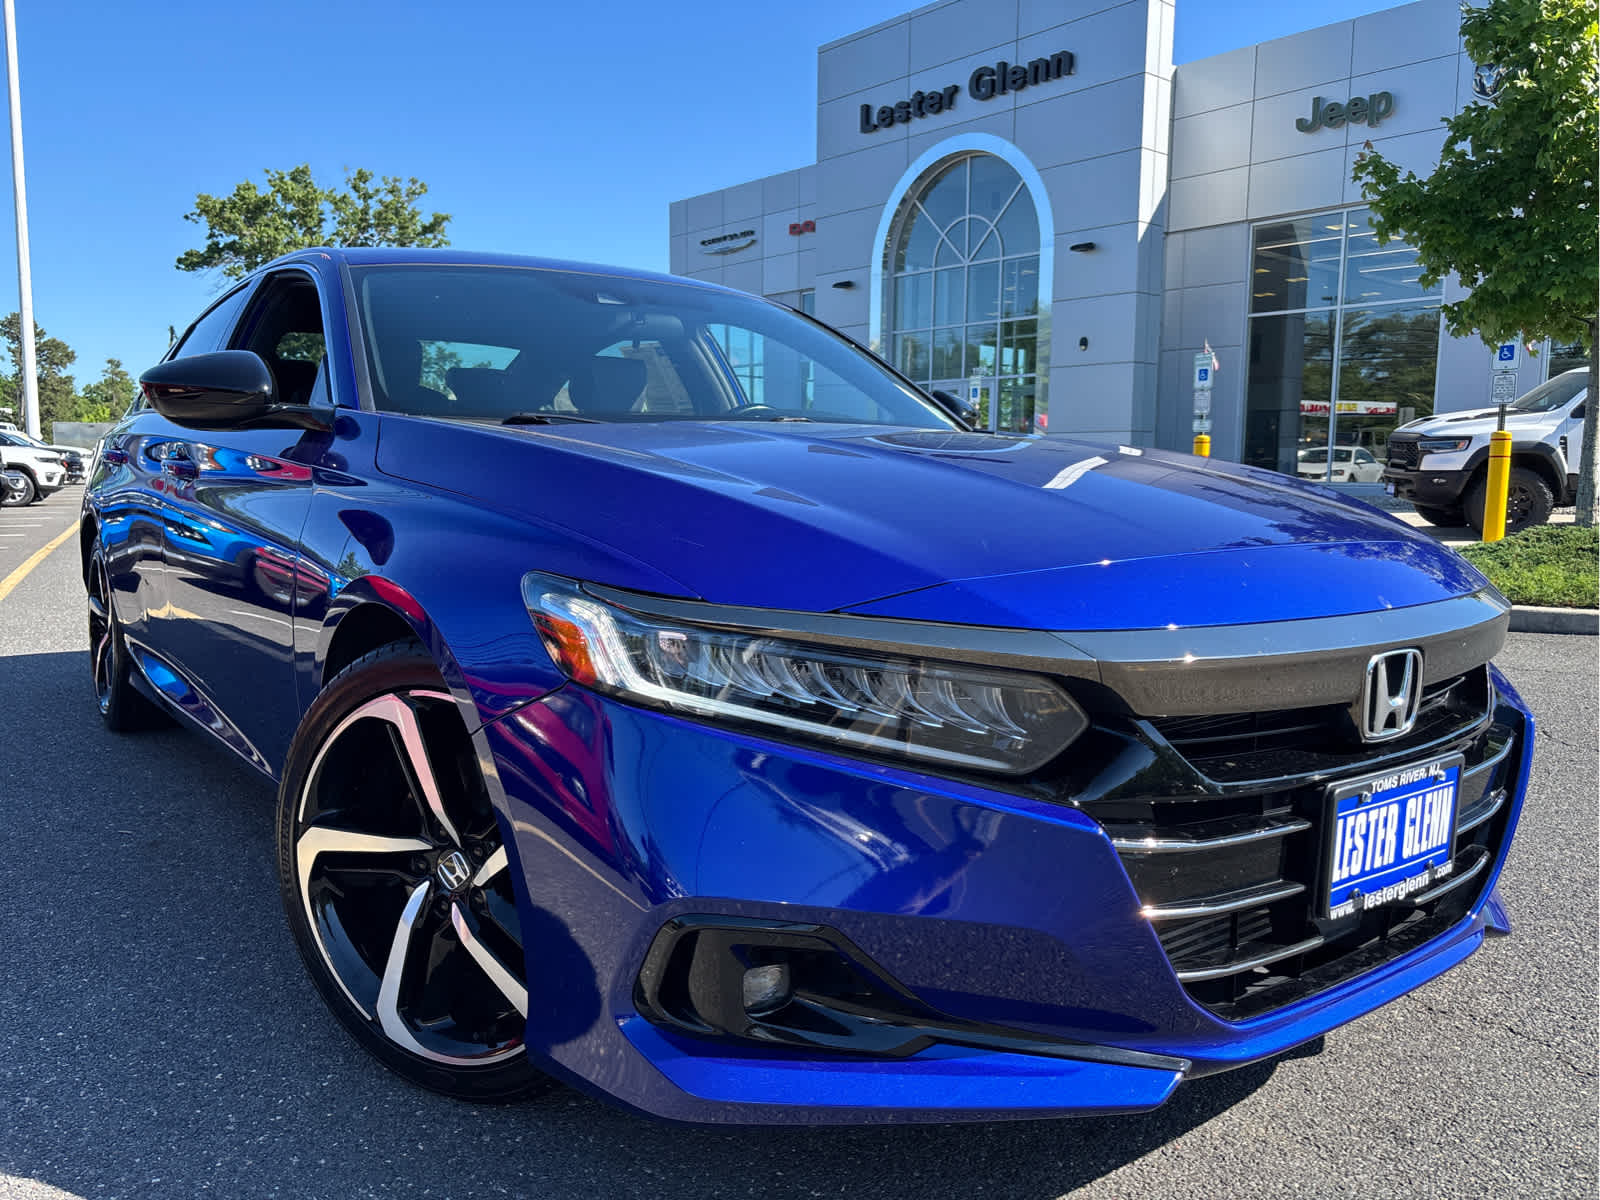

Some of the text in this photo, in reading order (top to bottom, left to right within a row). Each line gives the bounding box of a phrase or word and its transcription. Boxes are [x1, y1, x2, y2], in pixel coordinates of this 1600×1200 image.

[860, 50, 1076, 133] Lester Glenn
[1296, 91, 1393, 132] Jeep
[1371, 776, 1398, 794] TOMS
[1429, 763, 1441, 776] NJ
[1332, 786, 1454, 883] LESTER GLENN
